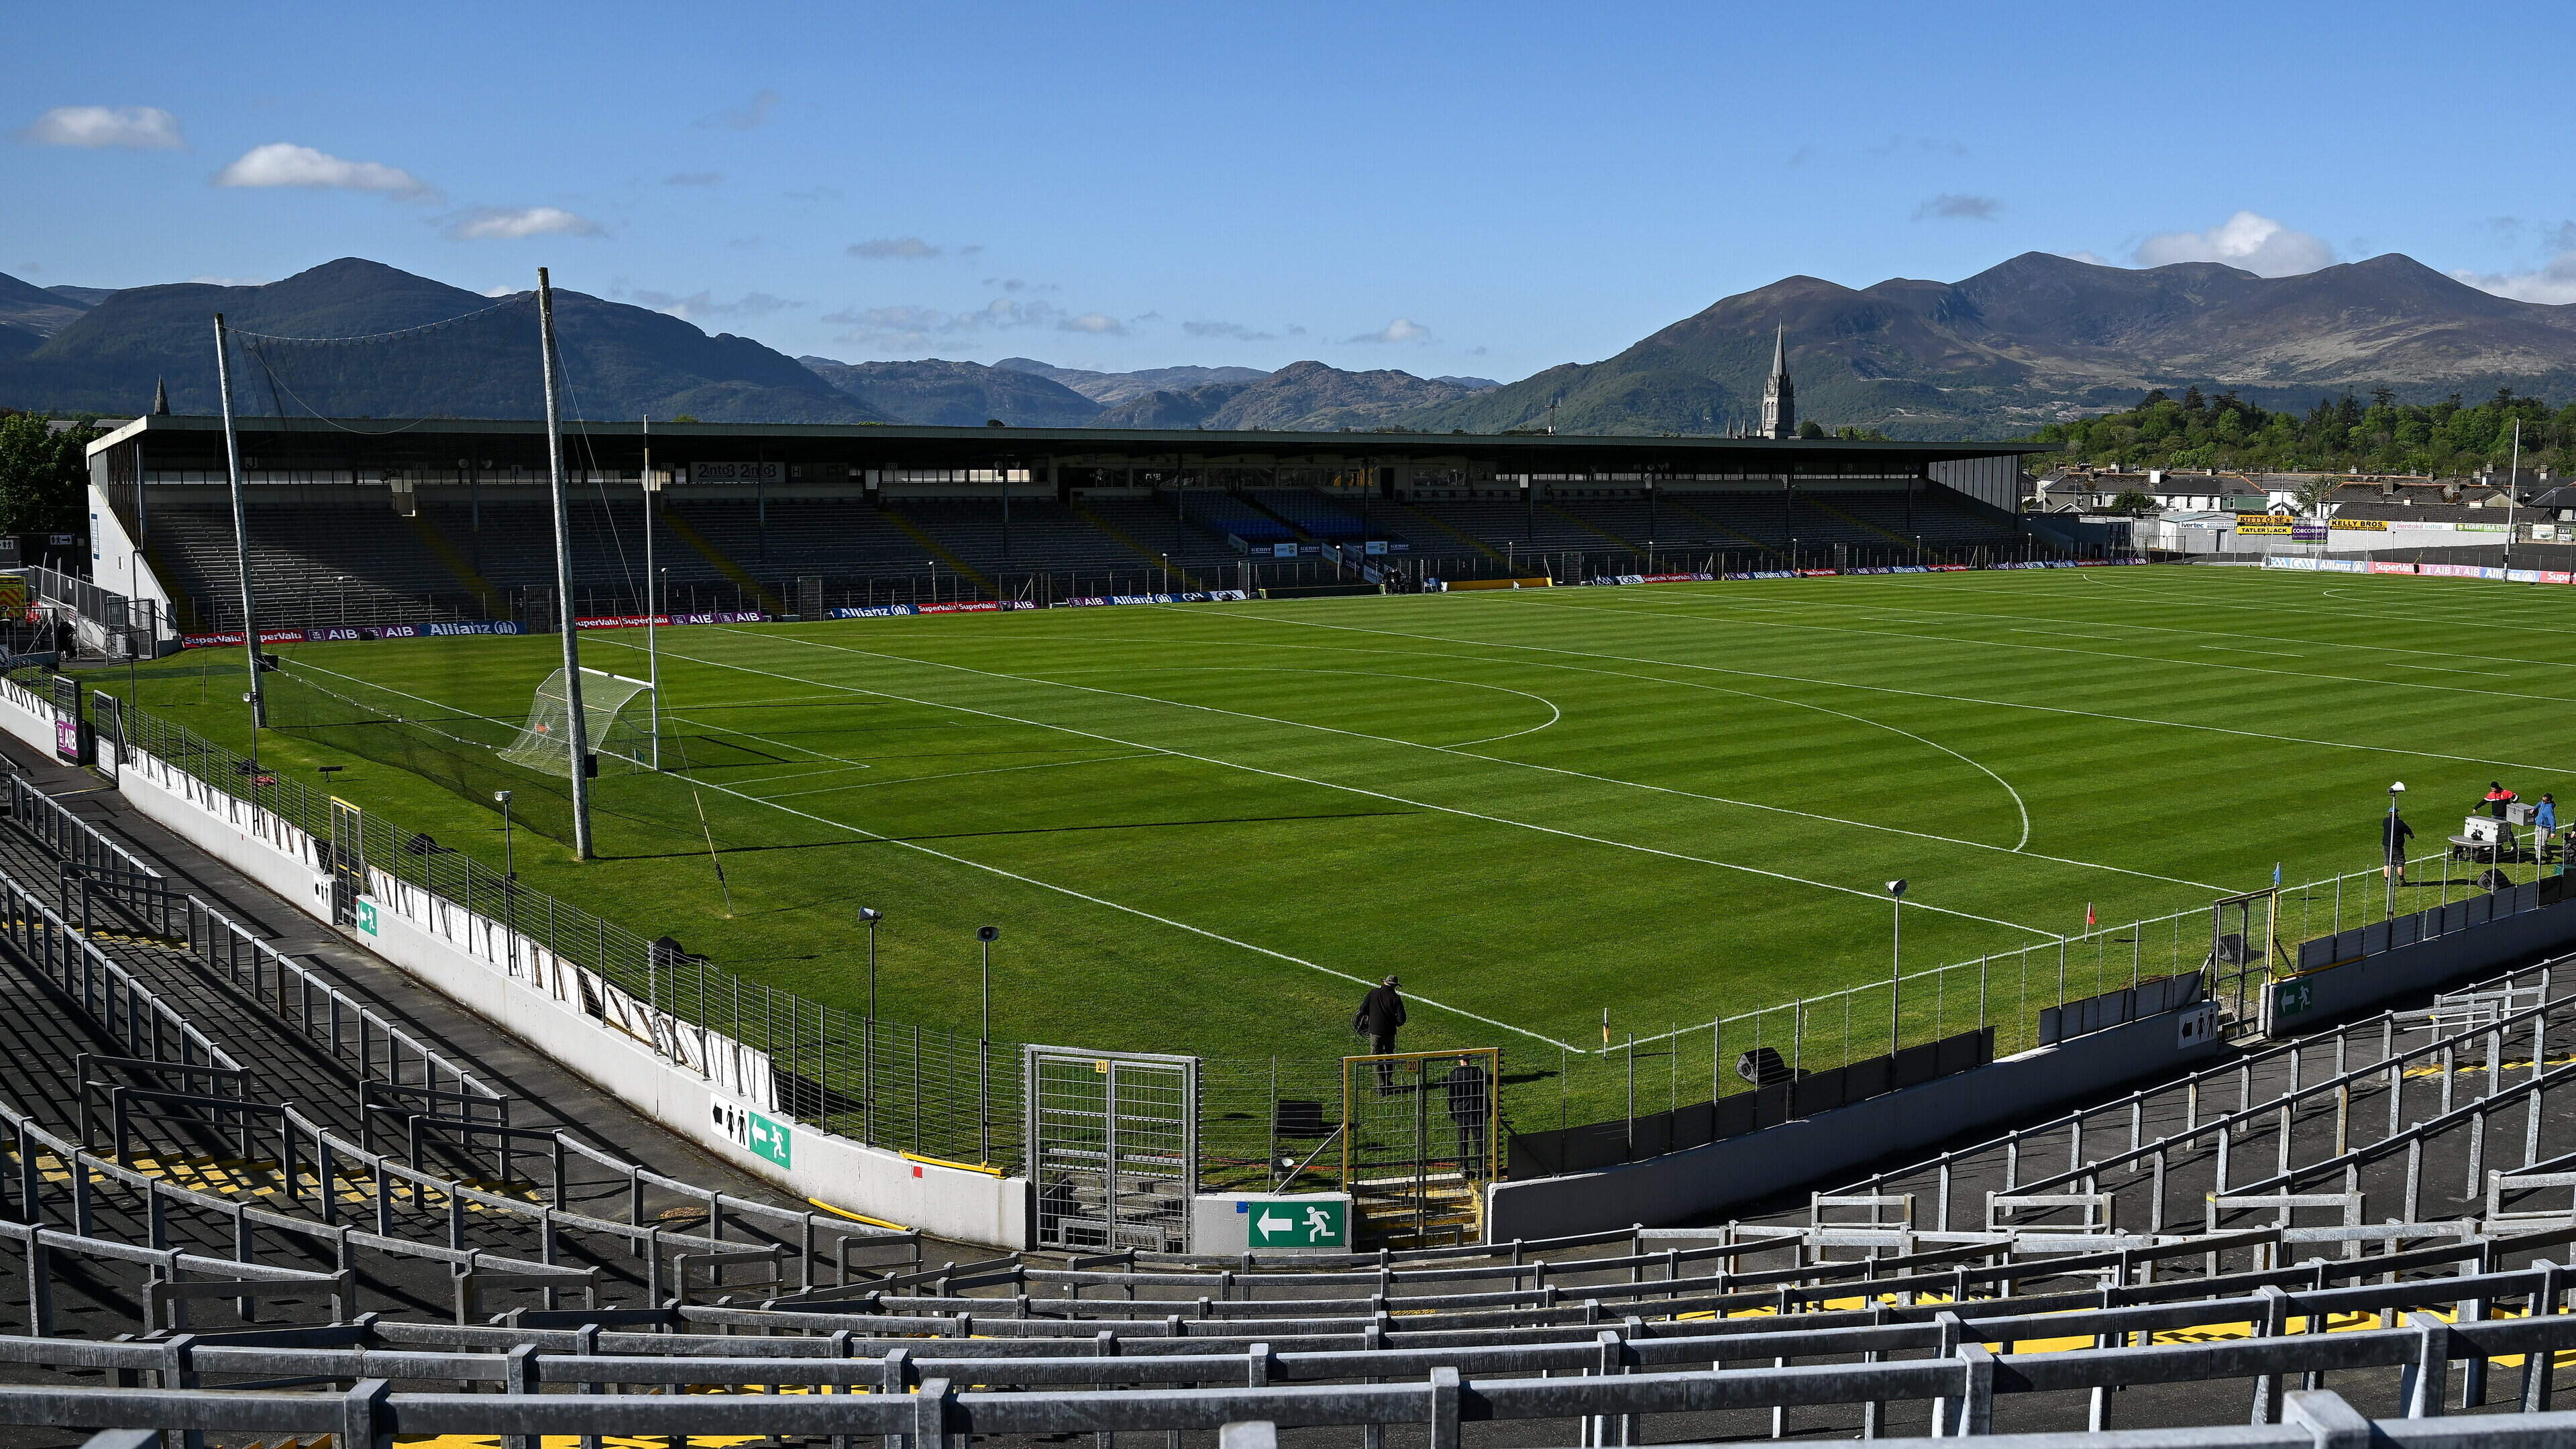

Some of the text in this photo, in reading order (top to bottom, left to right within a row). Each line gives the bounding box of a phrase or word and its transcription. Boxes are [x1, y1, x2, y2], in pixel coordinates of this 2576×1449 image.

[741, 464, 776, 477] 2ino3
[2321, 561, 2351, 570] Allianz
[2375, 562, 2414, 573] SuperVal
[2434, 564, 2451, 575] AIB
[2463, 566, 2480, 576] AIB
[1014, 601, 1034, 609] AIB
[1085, 598, 1104, 606] AIB
[1112, 596, 1155, 604] Allianz
[737, 612, 759, 622] AIB
[841, 607, 890, 617] Allianz
[623, 616, 668, 626] Superalu
[329, 629, 358, 639] AIB
[386, 627, 414, 637] AIB
[431, 623, 492, 636] Allianz
[185, 635, 241, 645] SuperValu
[65, 728, 76, 750] AIB
[1098, 1062, 1105, 1071] 21
[1409, 1061, 1416, 1071] 20
